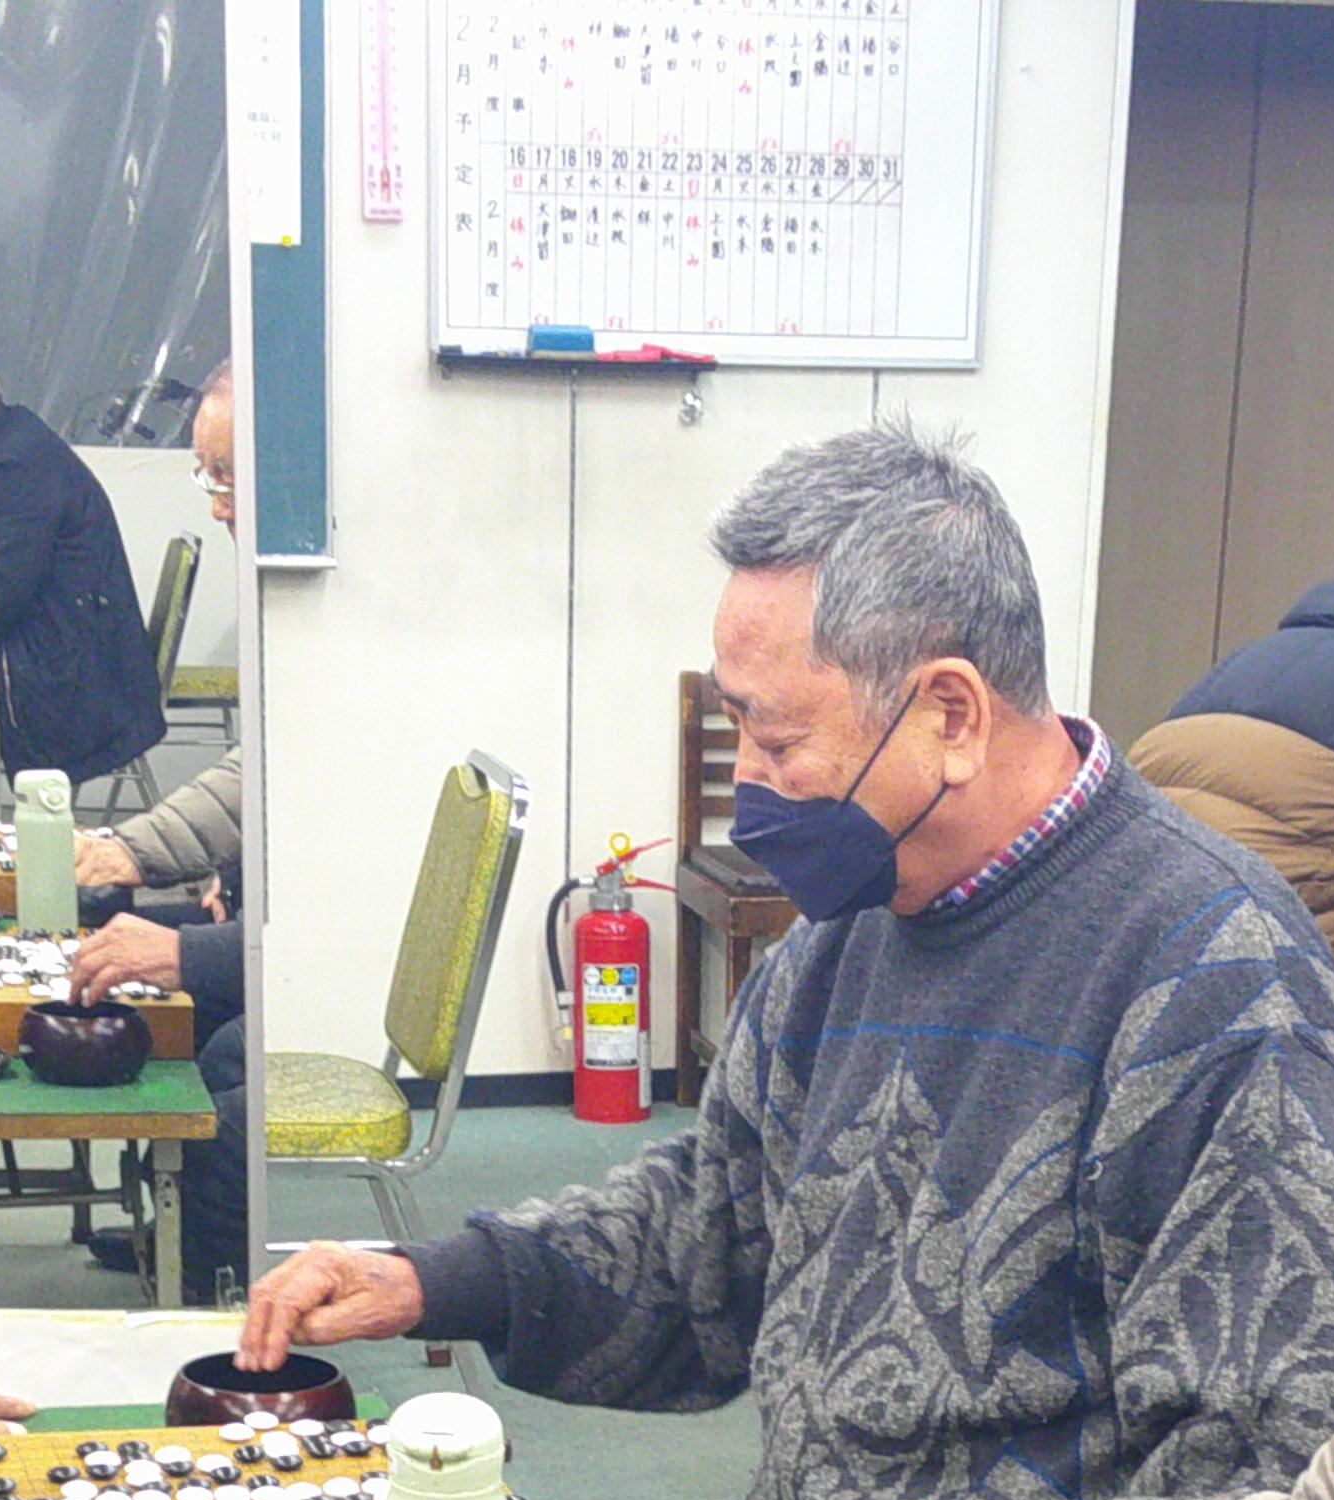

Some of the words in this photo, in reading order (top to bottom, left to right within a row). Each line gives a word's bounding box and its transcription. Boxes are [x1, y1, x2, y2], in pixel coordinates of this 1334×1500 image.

[510, 147, 525, 166] 16
[536, 148, 551, 167] 17
[562, 148, 576, 167] 18
[587, 149, 602, 168] 19
[612, 150, 628, 169] 20
[637, 151, 652, 170] 21
[662, 152, 678, 171] 22
[687, 153, 702, 172] 23
[711, 154, 727, 172] 24
[736, 154, 752, 173] 25
[761, 156, 776, 174] 26
[785, 156, 801, 174] 27
[810, 156, 825, 175] 28
[834, 157, 849, 177] 29
[858, 158, 874, 177] 30
[883, 160, 897, 178] 31
